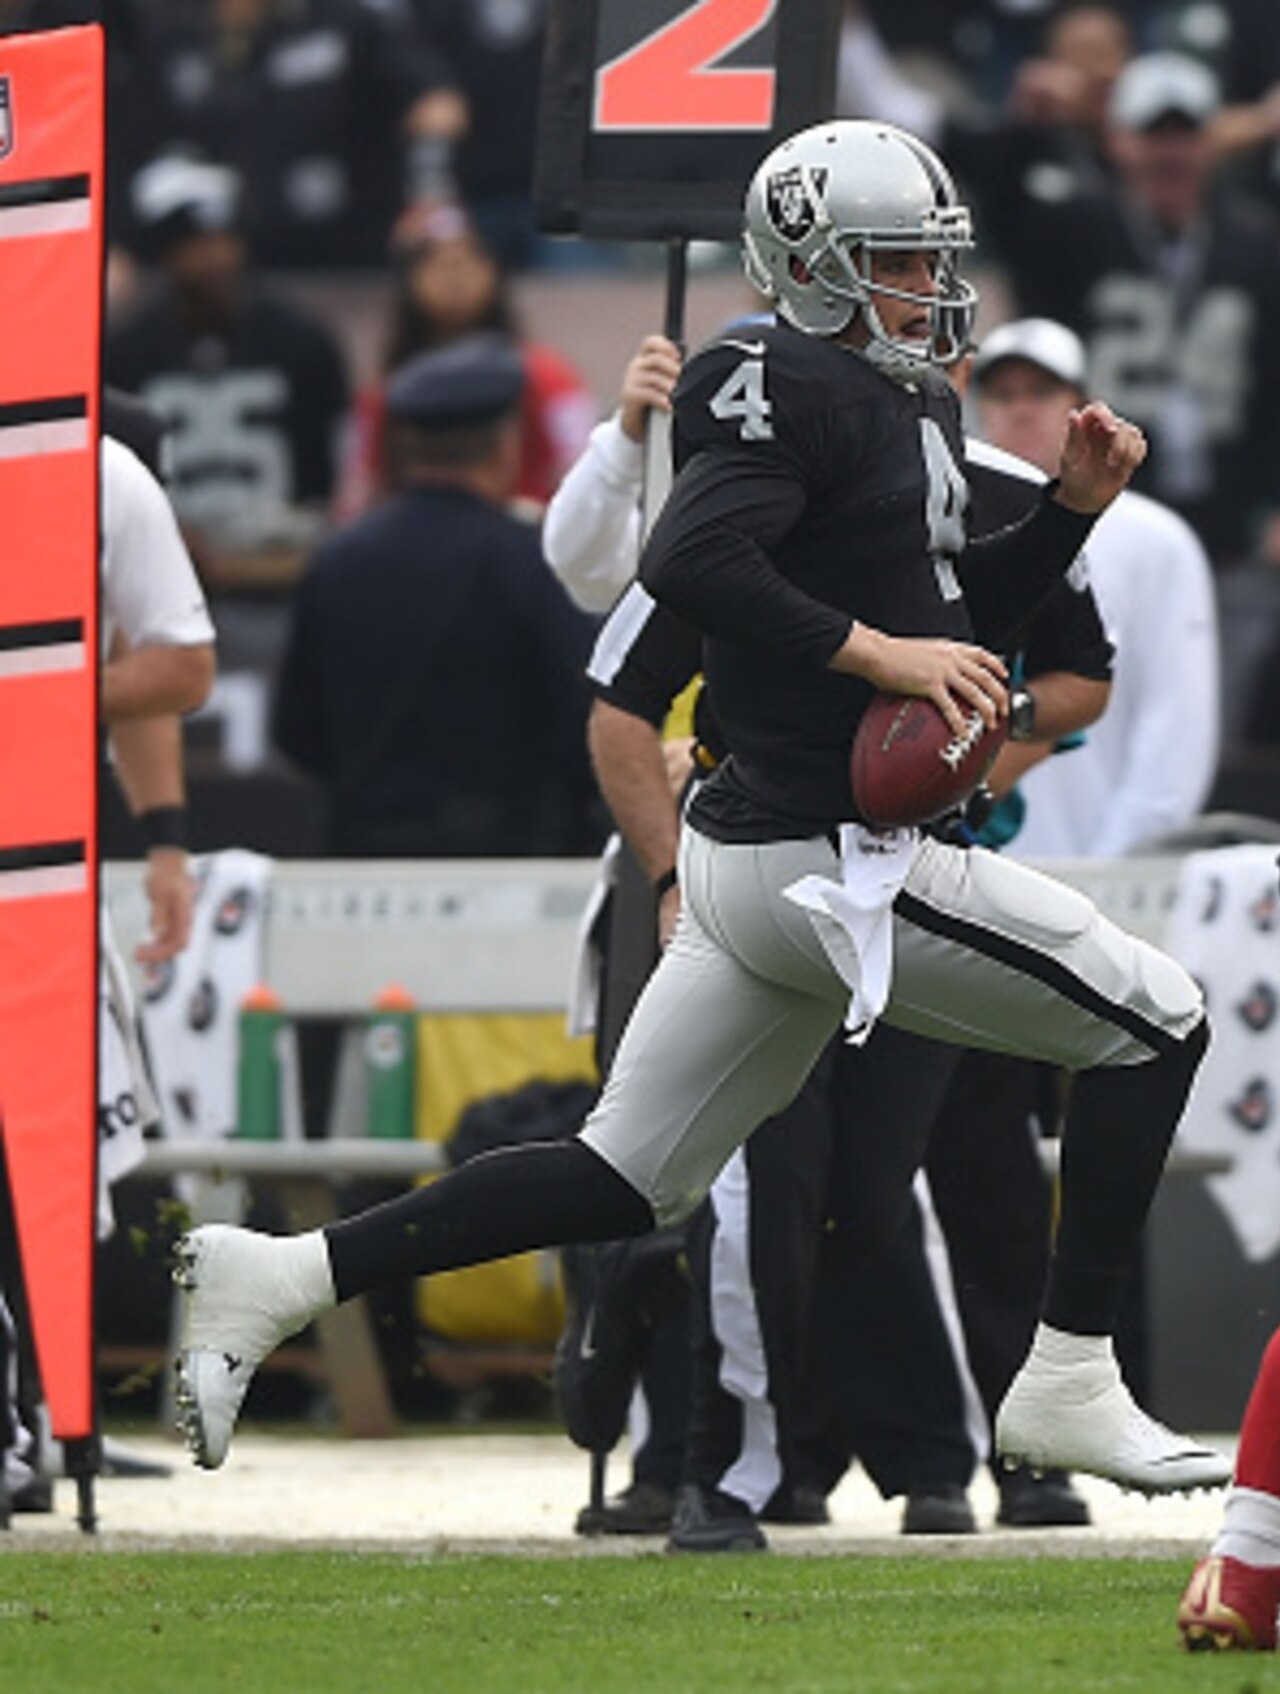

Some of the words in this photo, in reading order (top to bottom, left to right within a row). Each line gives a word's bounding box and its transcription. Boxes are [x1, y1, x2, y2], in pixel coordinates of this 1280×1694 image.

[592, 0, 777, 131] 2
[709, 359, 775, 440] 4
[918, 416, 970, 601] 4
